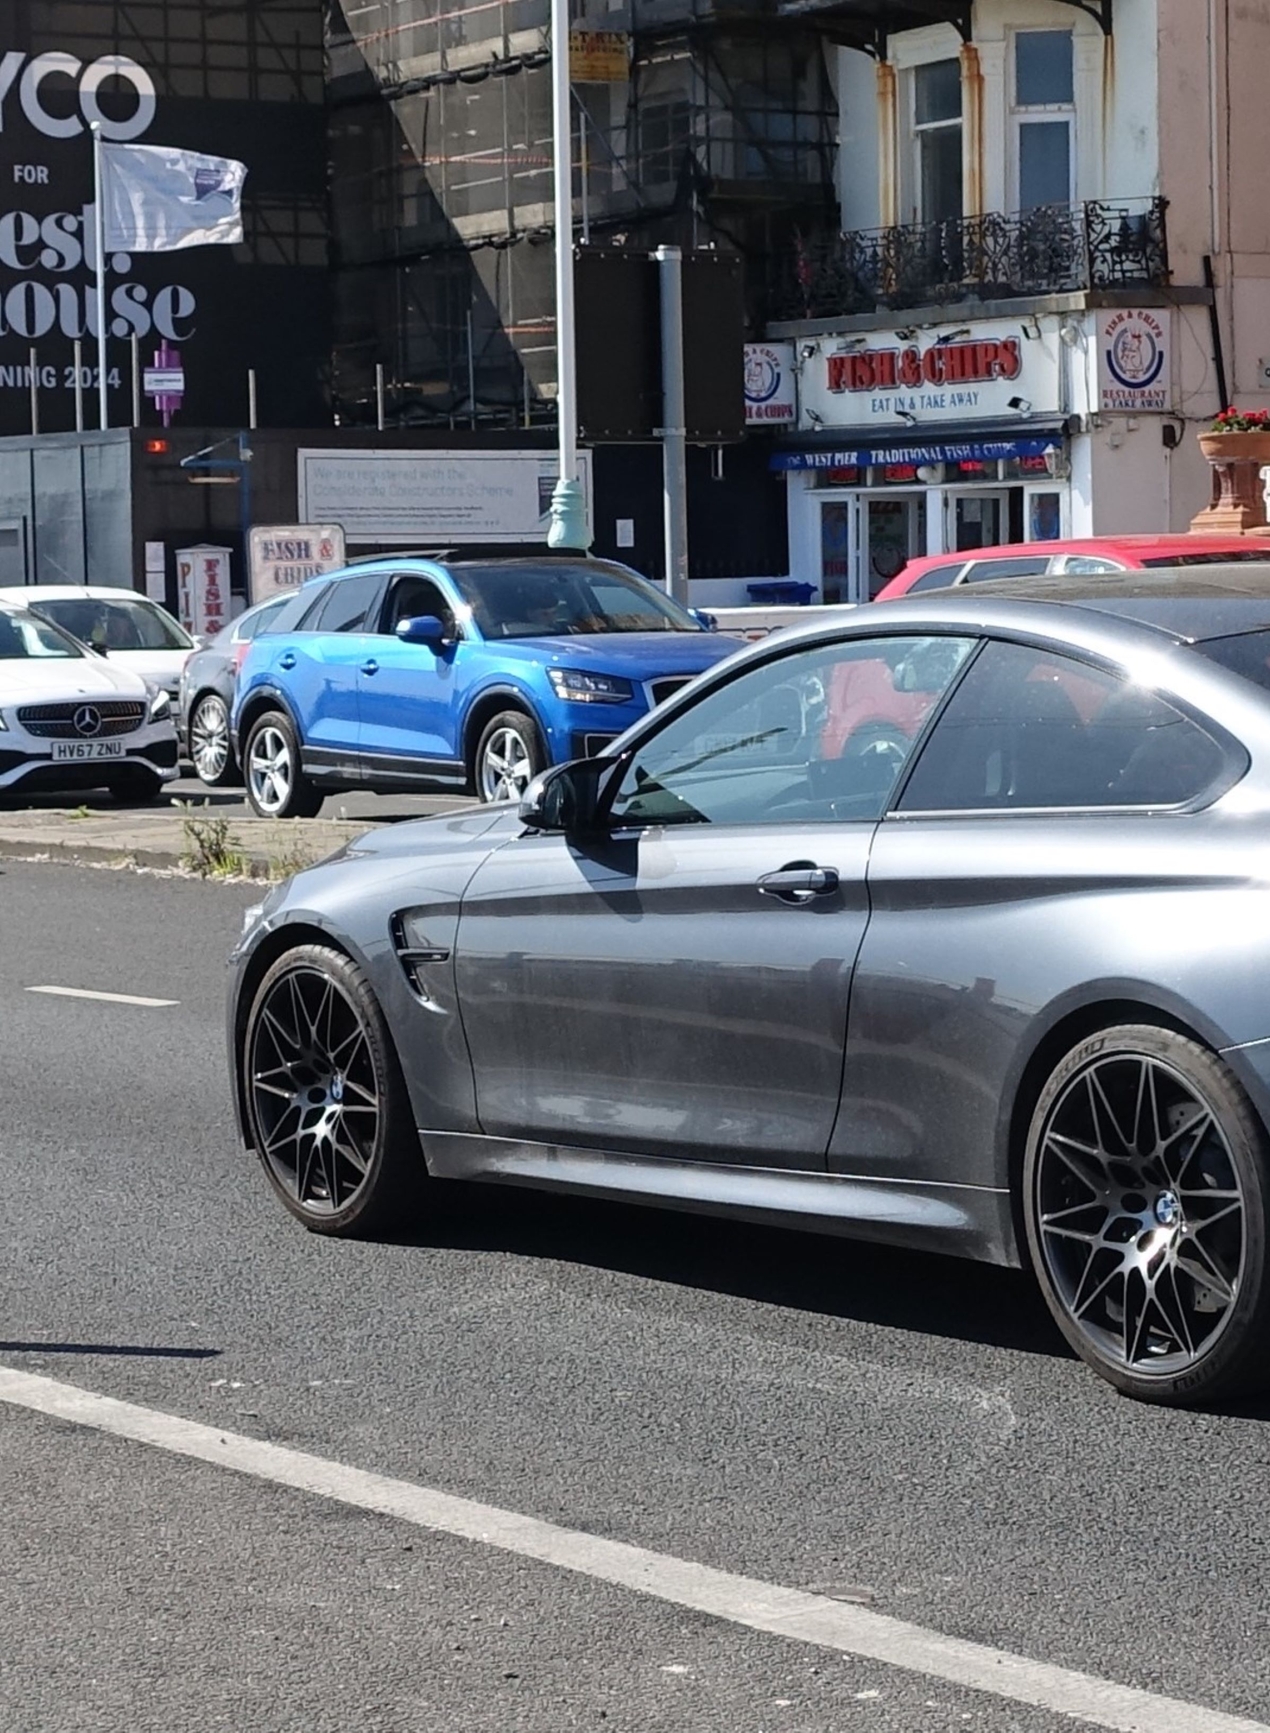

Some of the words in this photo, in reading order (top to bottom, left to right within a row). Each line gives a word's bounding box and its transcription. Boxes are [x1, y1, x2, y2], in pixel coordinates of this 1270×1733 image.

[14, 165, 49, 184] FOR
[0, 281, 196, 341] ouse
[1105, 312, 1125, 337] FISH
[1137, 310, 1163, 338] CHIPS
[827, 349, 899, 393] FISH
[923, 336, 1021, 387] CHIPS
[871, 397, 890, 412] EAT
[893, 396, 905, 411] IN
[908, 396, 916, 410] &
[920, 393, 946, 410] TAKE
[950, 391, 979, 408] AWAY
[1102, 389, 1167, 400] RESTAURANT
[1112, 400, 1137, 409] TAKE
[1140, 399, 1166, 409] AWAY
[805, 453, 832, 466] WEST
[834, 451, 858, 465] PIER
[870, 446, 943, 464] TRADITIONAL
[262, 540, 312, 561] FISH
[319, 538, 334, 560] &
[58, 744, 93, 757] HV67
[97, 742, 121, 756] ZNU
